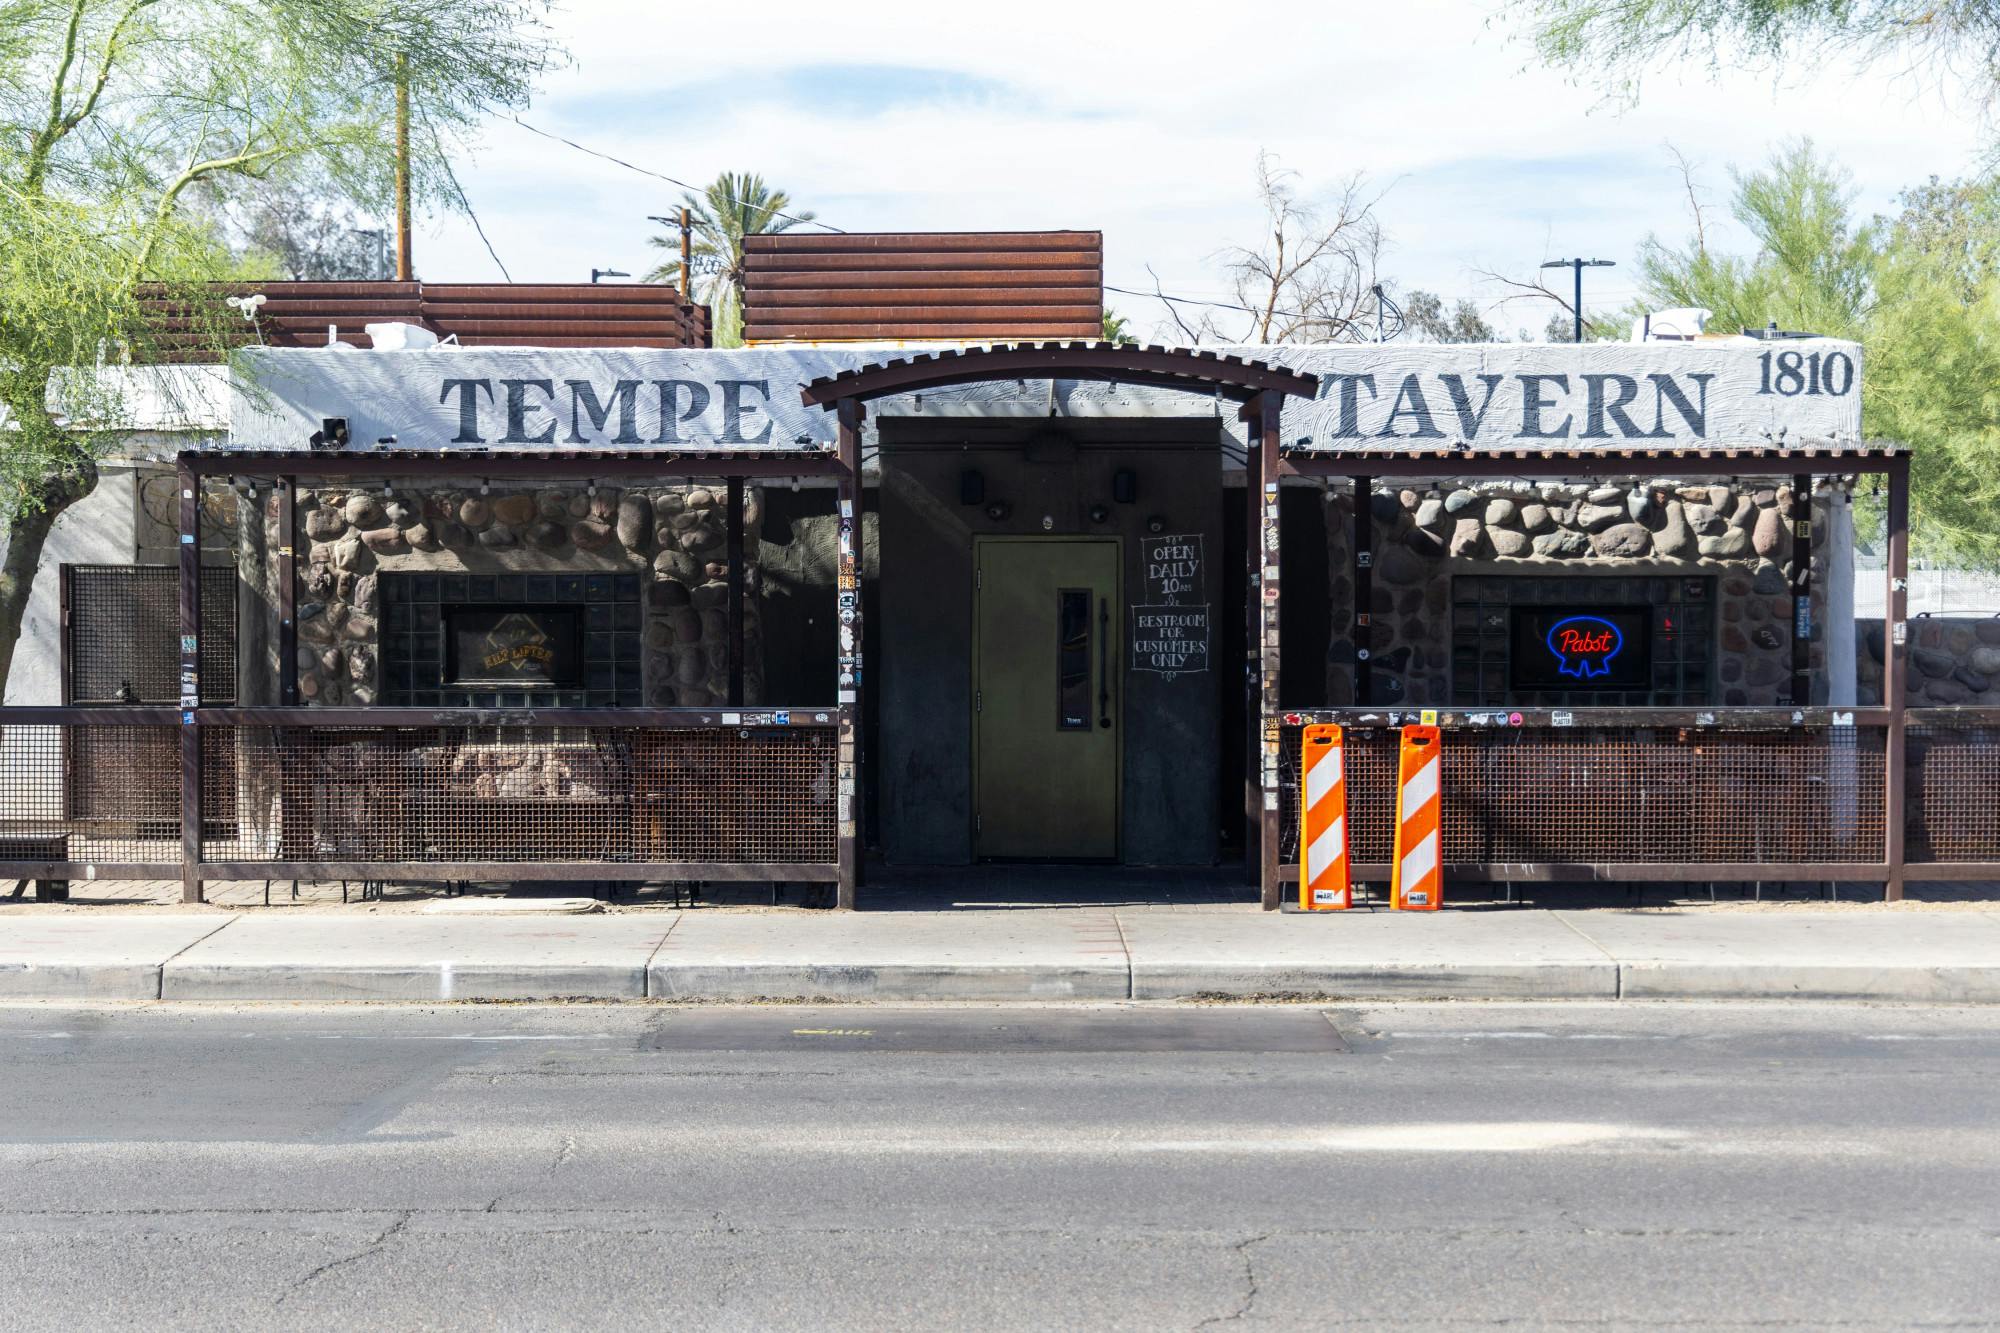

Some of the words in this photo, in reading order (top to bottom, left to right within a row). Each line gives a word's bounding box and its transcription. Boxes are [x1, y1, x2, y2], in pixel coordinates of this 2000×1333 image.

[1756, 350, 1854, 397] 1810
[439, 378, 773, 445] TEMPE
[1320, 373, 1716, 440] TAVERN
[1153, 545, 1195, 561] OPEN
[1150, 560, 1200, 579] DAILY
[1138, 614, 1206, 628] RESTROOM
[1160, 627, 1184, 638] FOR
[1560, 629, 1614, 653] Pabst
[1135, 640, 1206, 654] CUSTOMERS
[1151, 653, 1188, 667] ONLY
